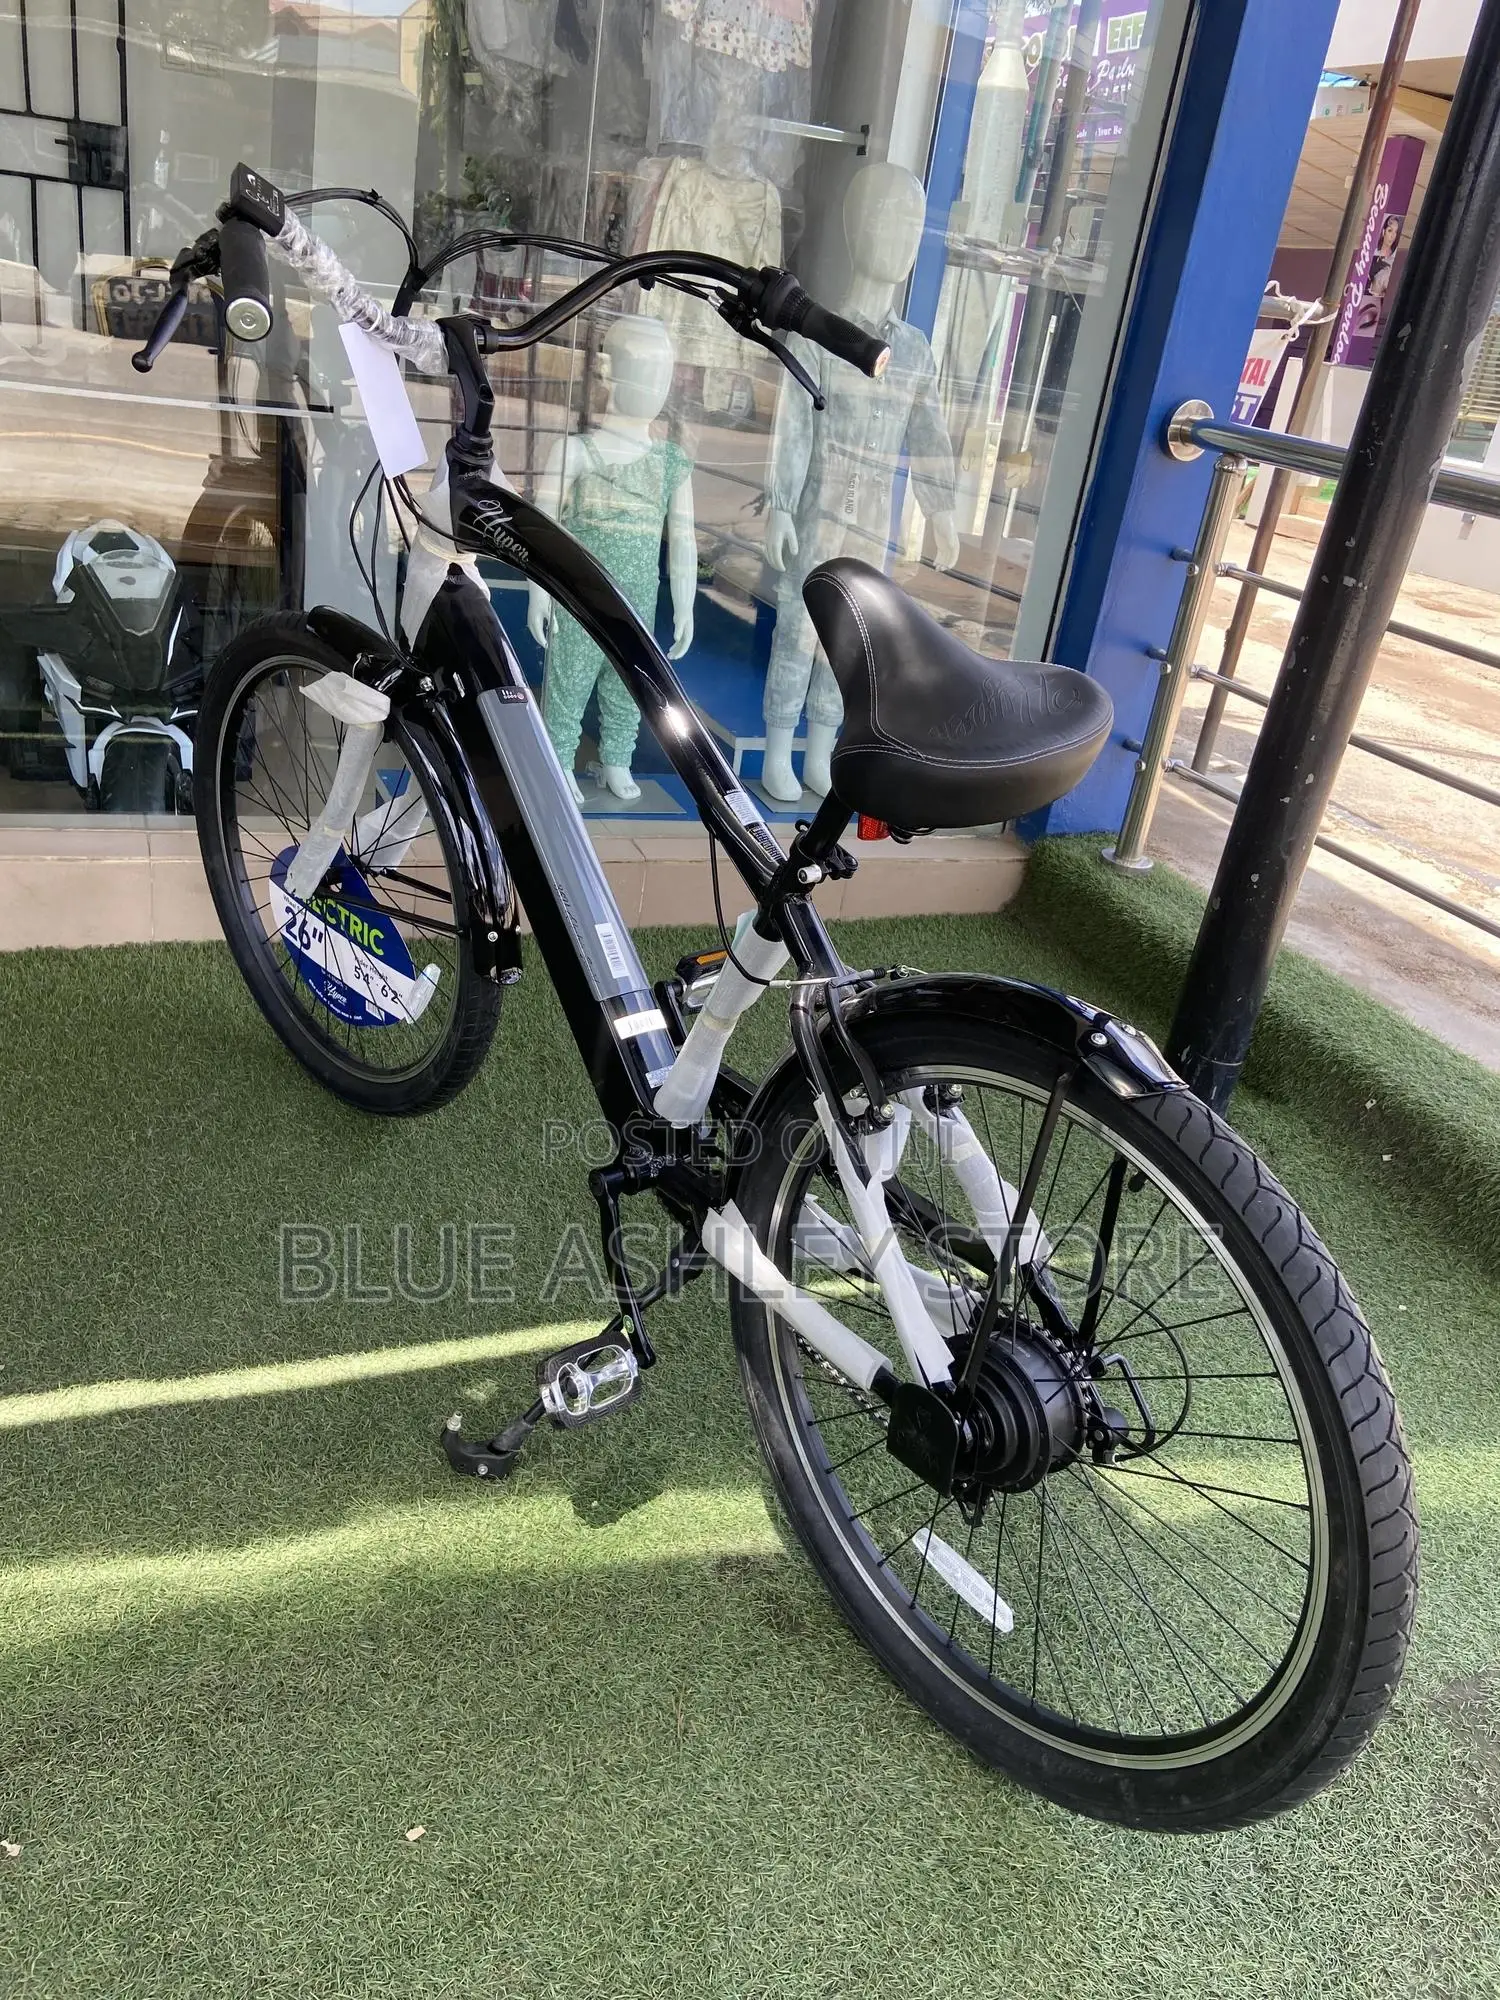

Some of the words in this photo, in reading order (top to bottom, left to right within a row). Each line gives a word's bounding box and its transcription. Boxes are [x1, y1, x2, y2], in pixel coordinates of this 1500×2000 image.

[1355, 183, 1389, 276] Beauty
[473, 500, 529, 562] Hyper
[284, 905, 324, 951] 26"
